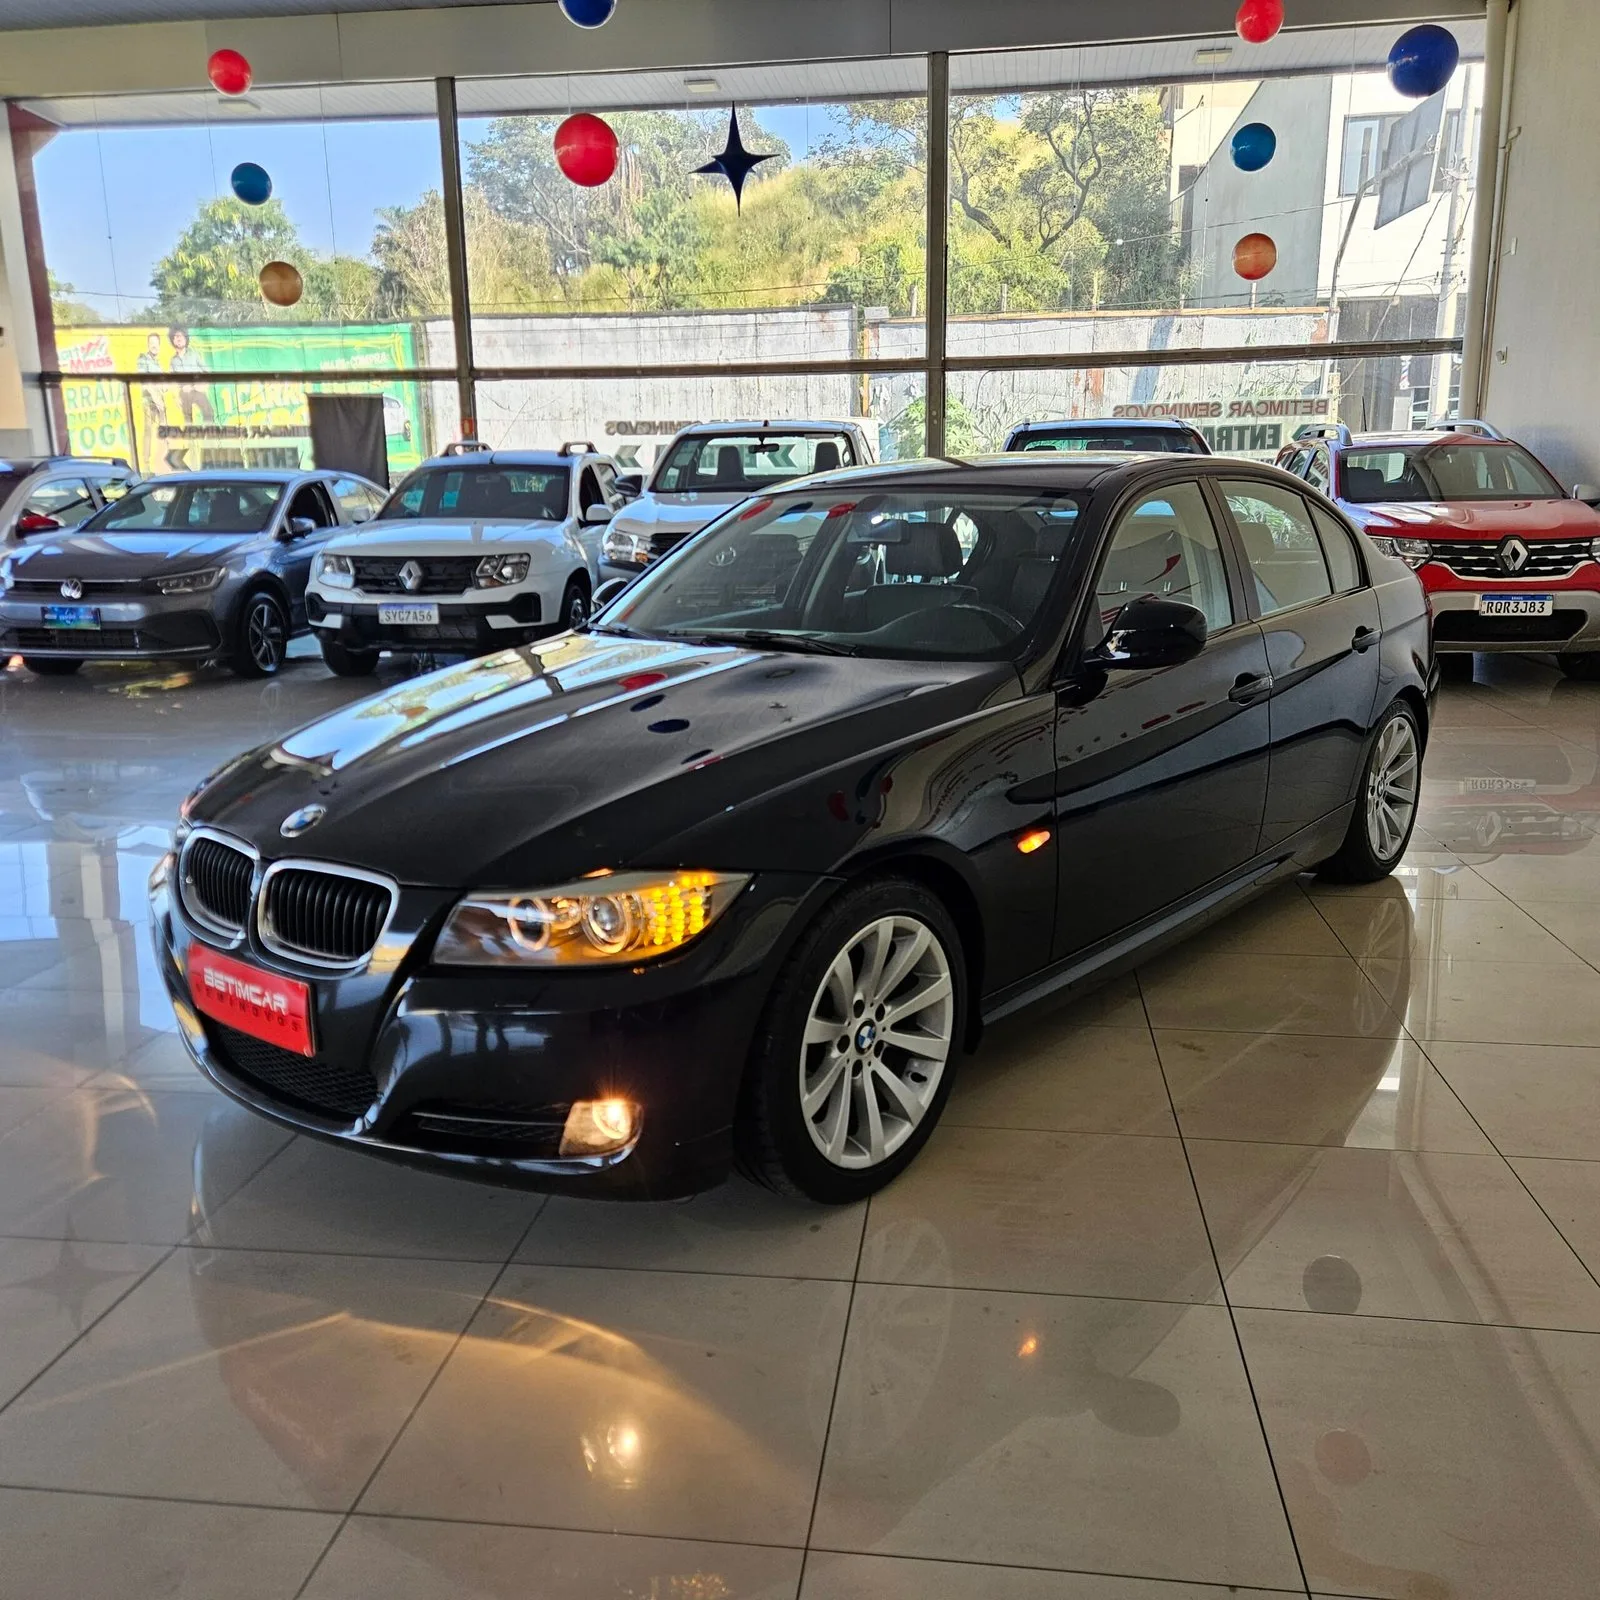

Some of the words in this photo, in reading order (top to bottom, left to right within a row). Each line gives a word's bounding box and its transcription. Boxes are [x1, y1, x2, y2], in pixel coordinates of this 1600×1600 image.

[1485, 601, 1546, 614] RQR3J83
[384, 610, 432, 622] SYC7A56
[203, 969, 287, 1015] BETIMCAR
